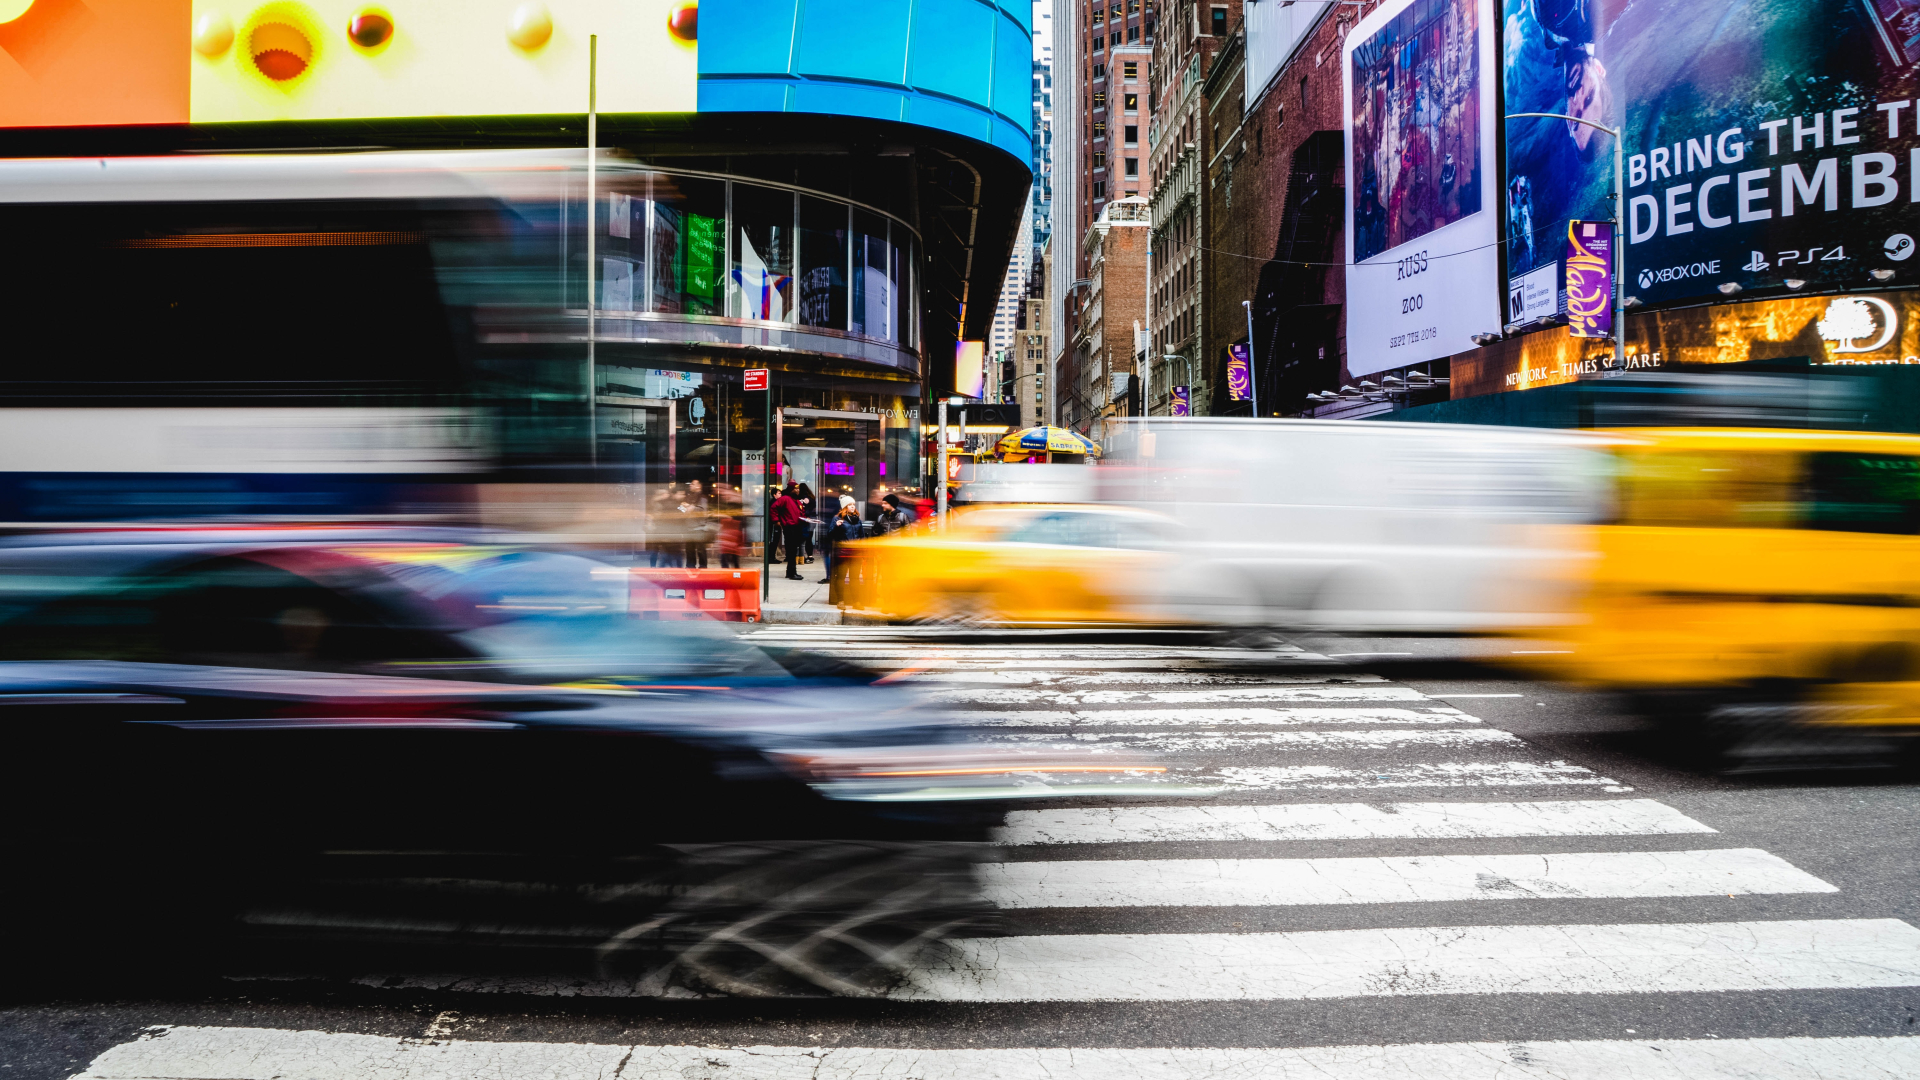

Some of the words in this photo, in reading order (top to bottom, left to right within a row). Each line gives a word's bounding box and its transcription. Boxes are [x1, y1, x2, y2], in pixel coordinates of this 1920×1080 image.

[1628, 128, 1744, 188] BRING
[1759, 106, 1860, 156] THE
[1876, 98, 1920, 140] T
[1397, 250, 1428, 281] RUSS
[1777, 246, 1848, 267] PS4
[1566, 219, 1607, 338] Aladdin
[1655, 263, 1690, 285] XBOX
[1690, 259, 1721, 281] ONE
[1402, 294, 1423, 314] ZOO
[1512, 290, 1522, 319] M
[1390, 333, 1406, 348] SEPT
[1407, 331, 1420, 345] 7TH
[1420, 327, 1437, 342] 2018
[1227, 344, 1247, 401] Aladdin
[1506, 373, 1523, 386] NEW
[1523, 366, 1548, 383] YORK
[1562, 359, 1597, 377] TIMES
[1050, 442, 1082, 450] SABRETT
